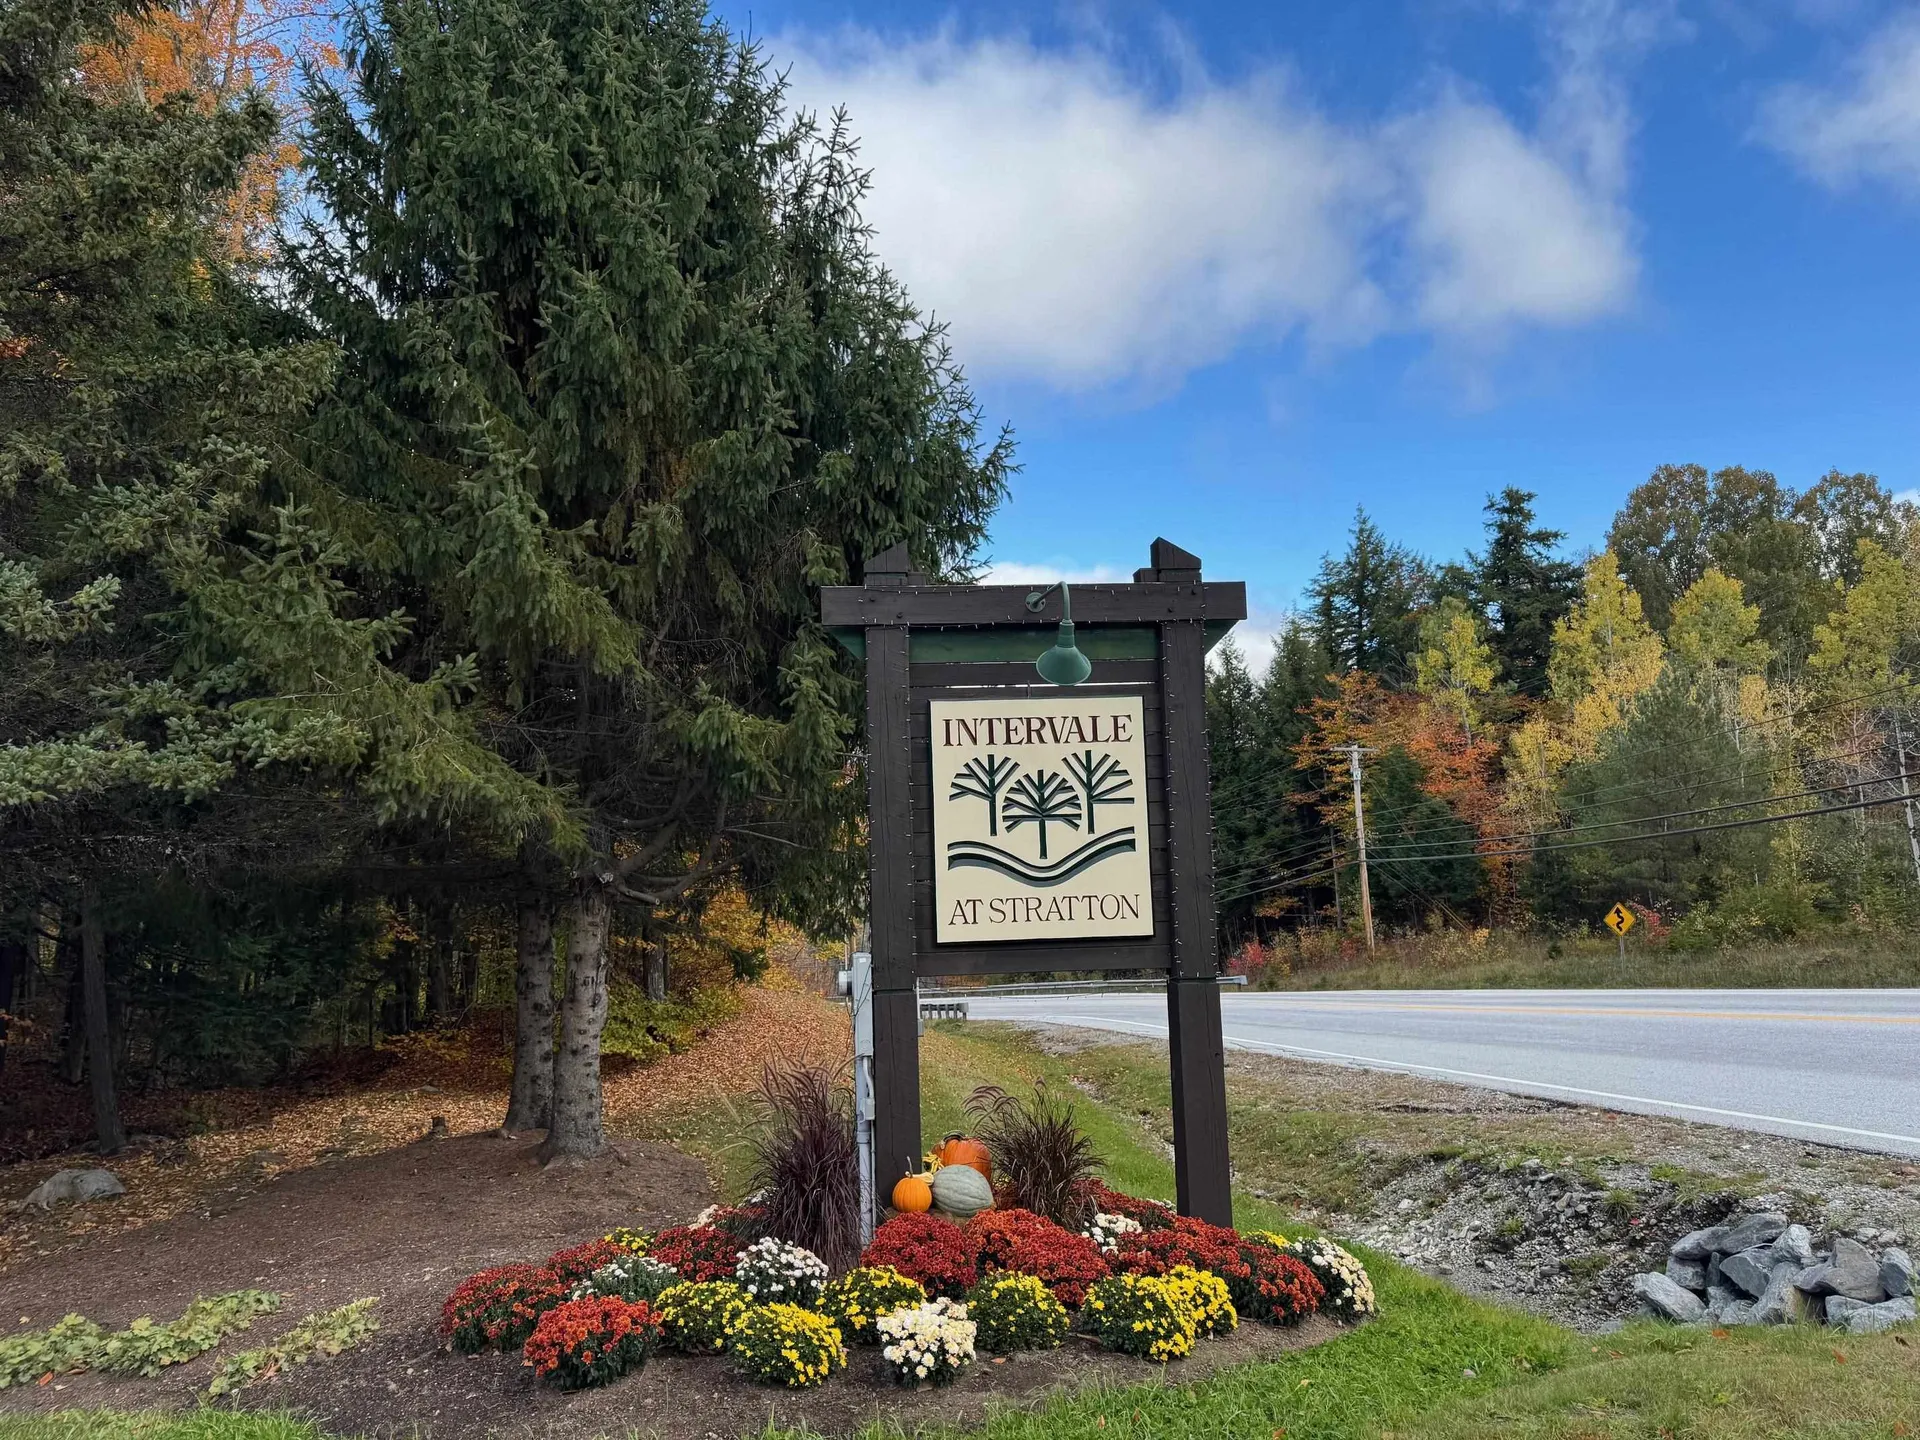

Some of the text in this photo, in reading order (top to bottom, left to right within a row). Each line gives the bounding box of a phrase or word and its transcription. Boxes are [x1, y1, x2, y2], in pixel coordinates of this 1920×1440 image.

[942, 714, 1133, 746] INTERVALE
[948, 894, 1140, 926] AT STRATTON
